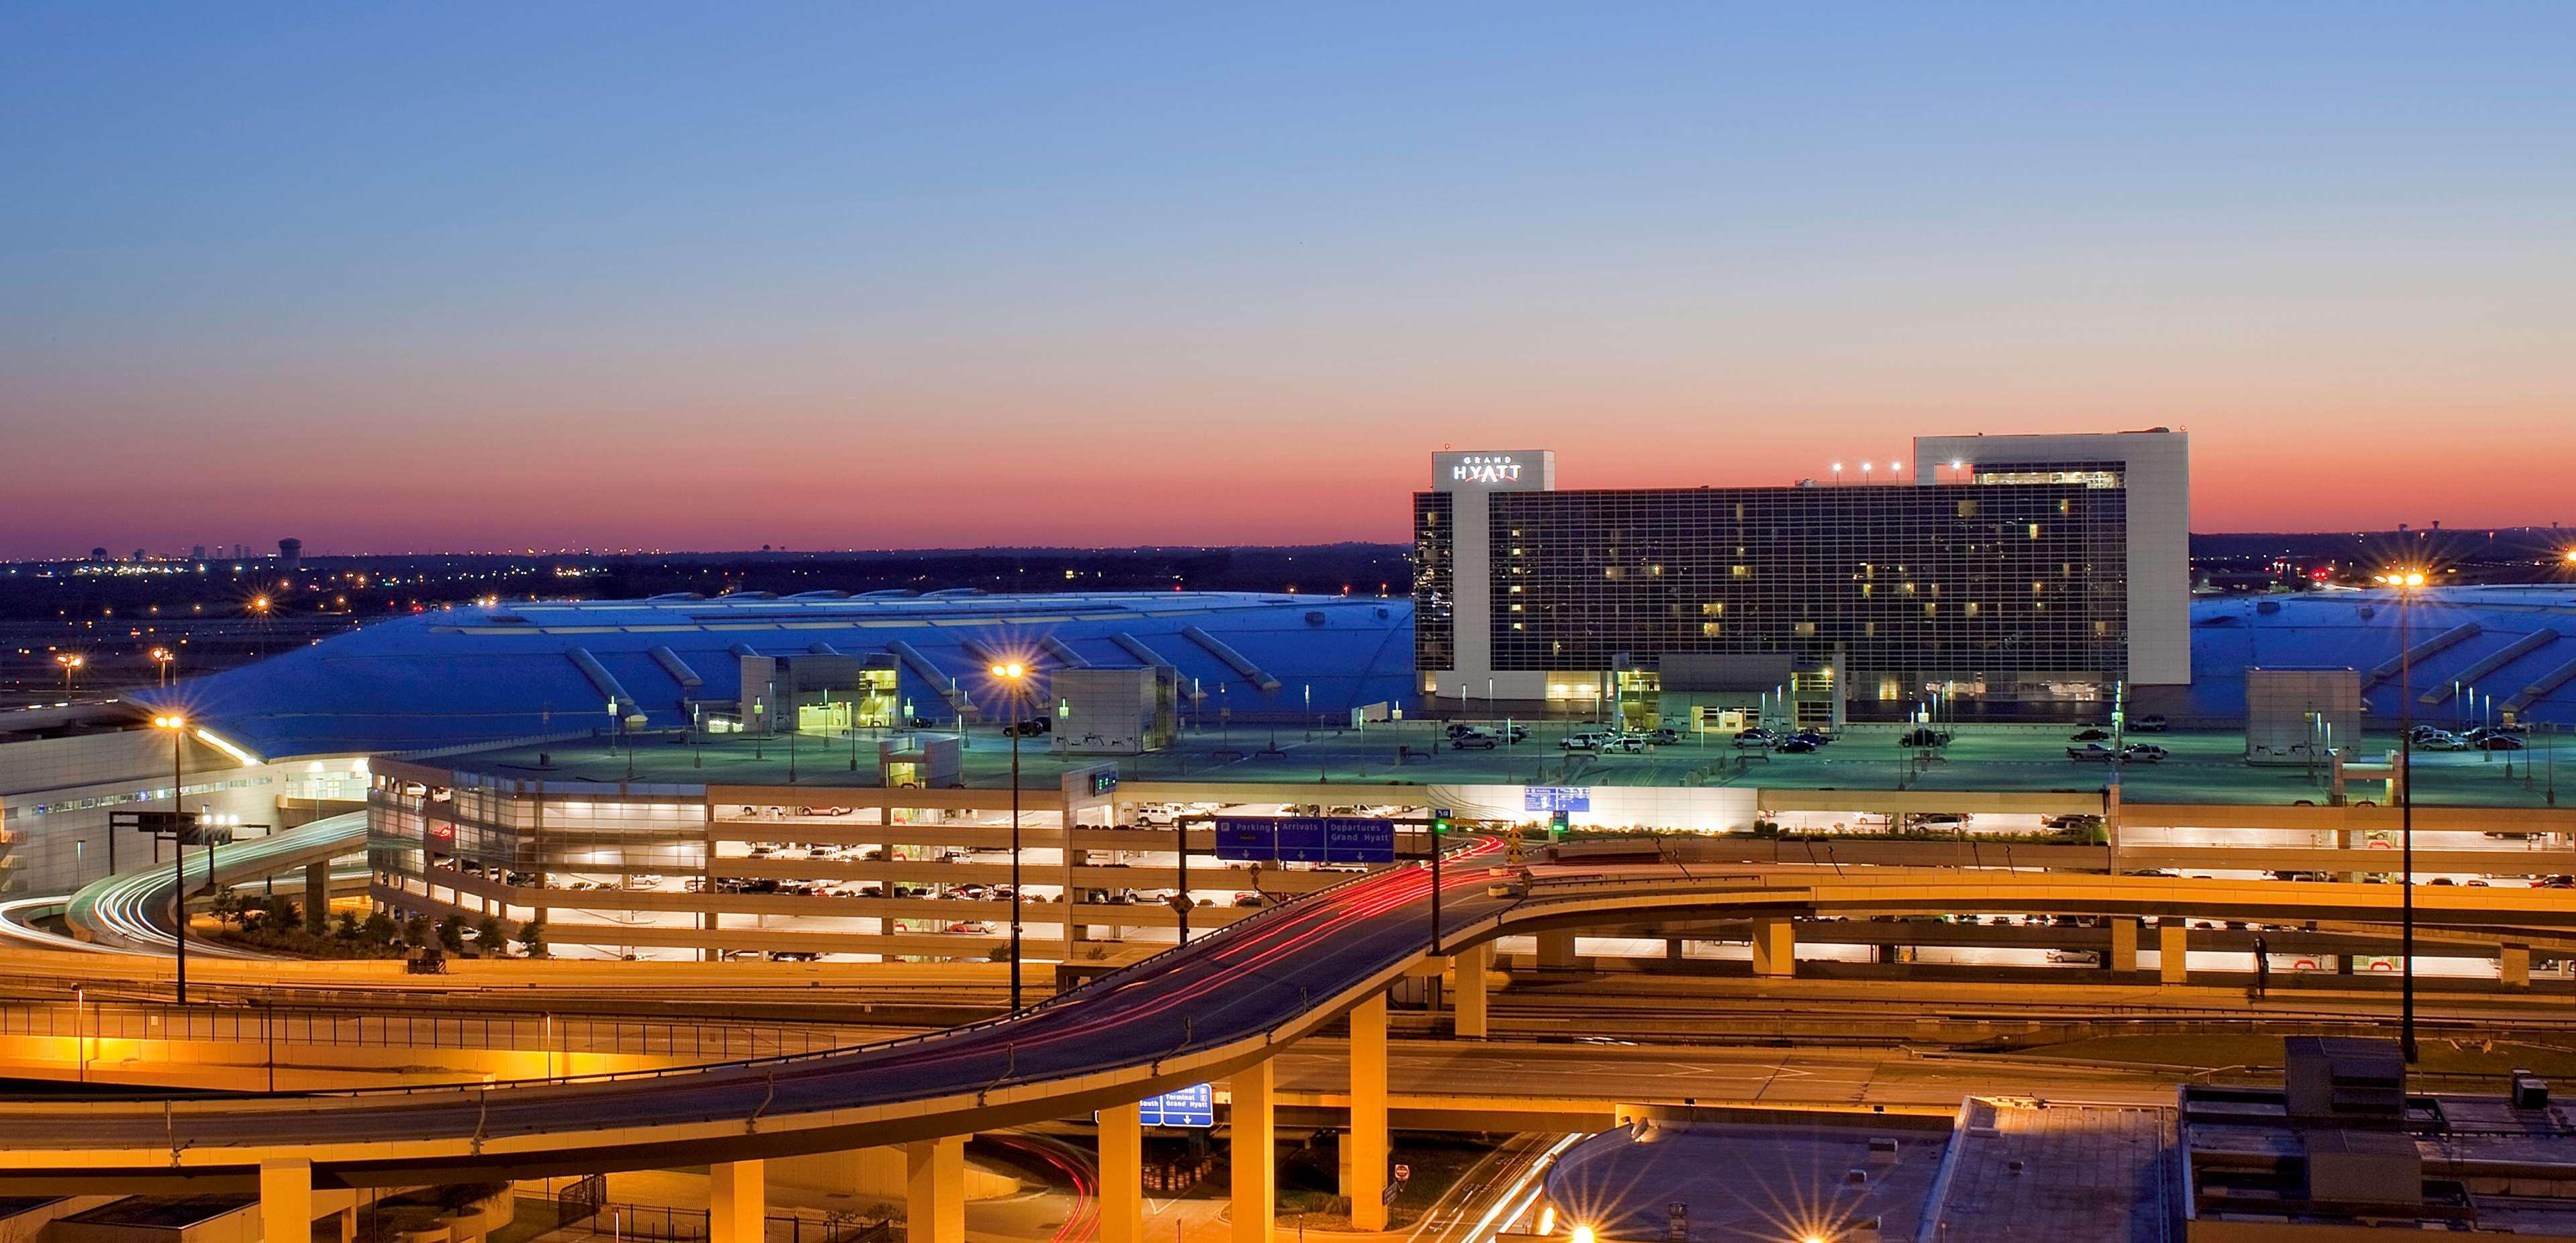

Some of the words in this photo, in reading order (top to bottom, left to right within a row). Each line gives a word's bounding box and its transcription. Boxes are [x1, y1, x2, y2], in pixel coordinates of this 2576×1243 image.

[1463, 456, 1512, 464] GRAND
[1453, 464, 1523, 483] HYATT
[1236, 823, 1271, 833] Parking
[1282, 823, 1319, 831] Arrivals
[1331, 824, 1380, 832] Departures
[1363, 834, 1389, 842] Hyatt
[1190, 1101, 1208, 1109] Hyatt
